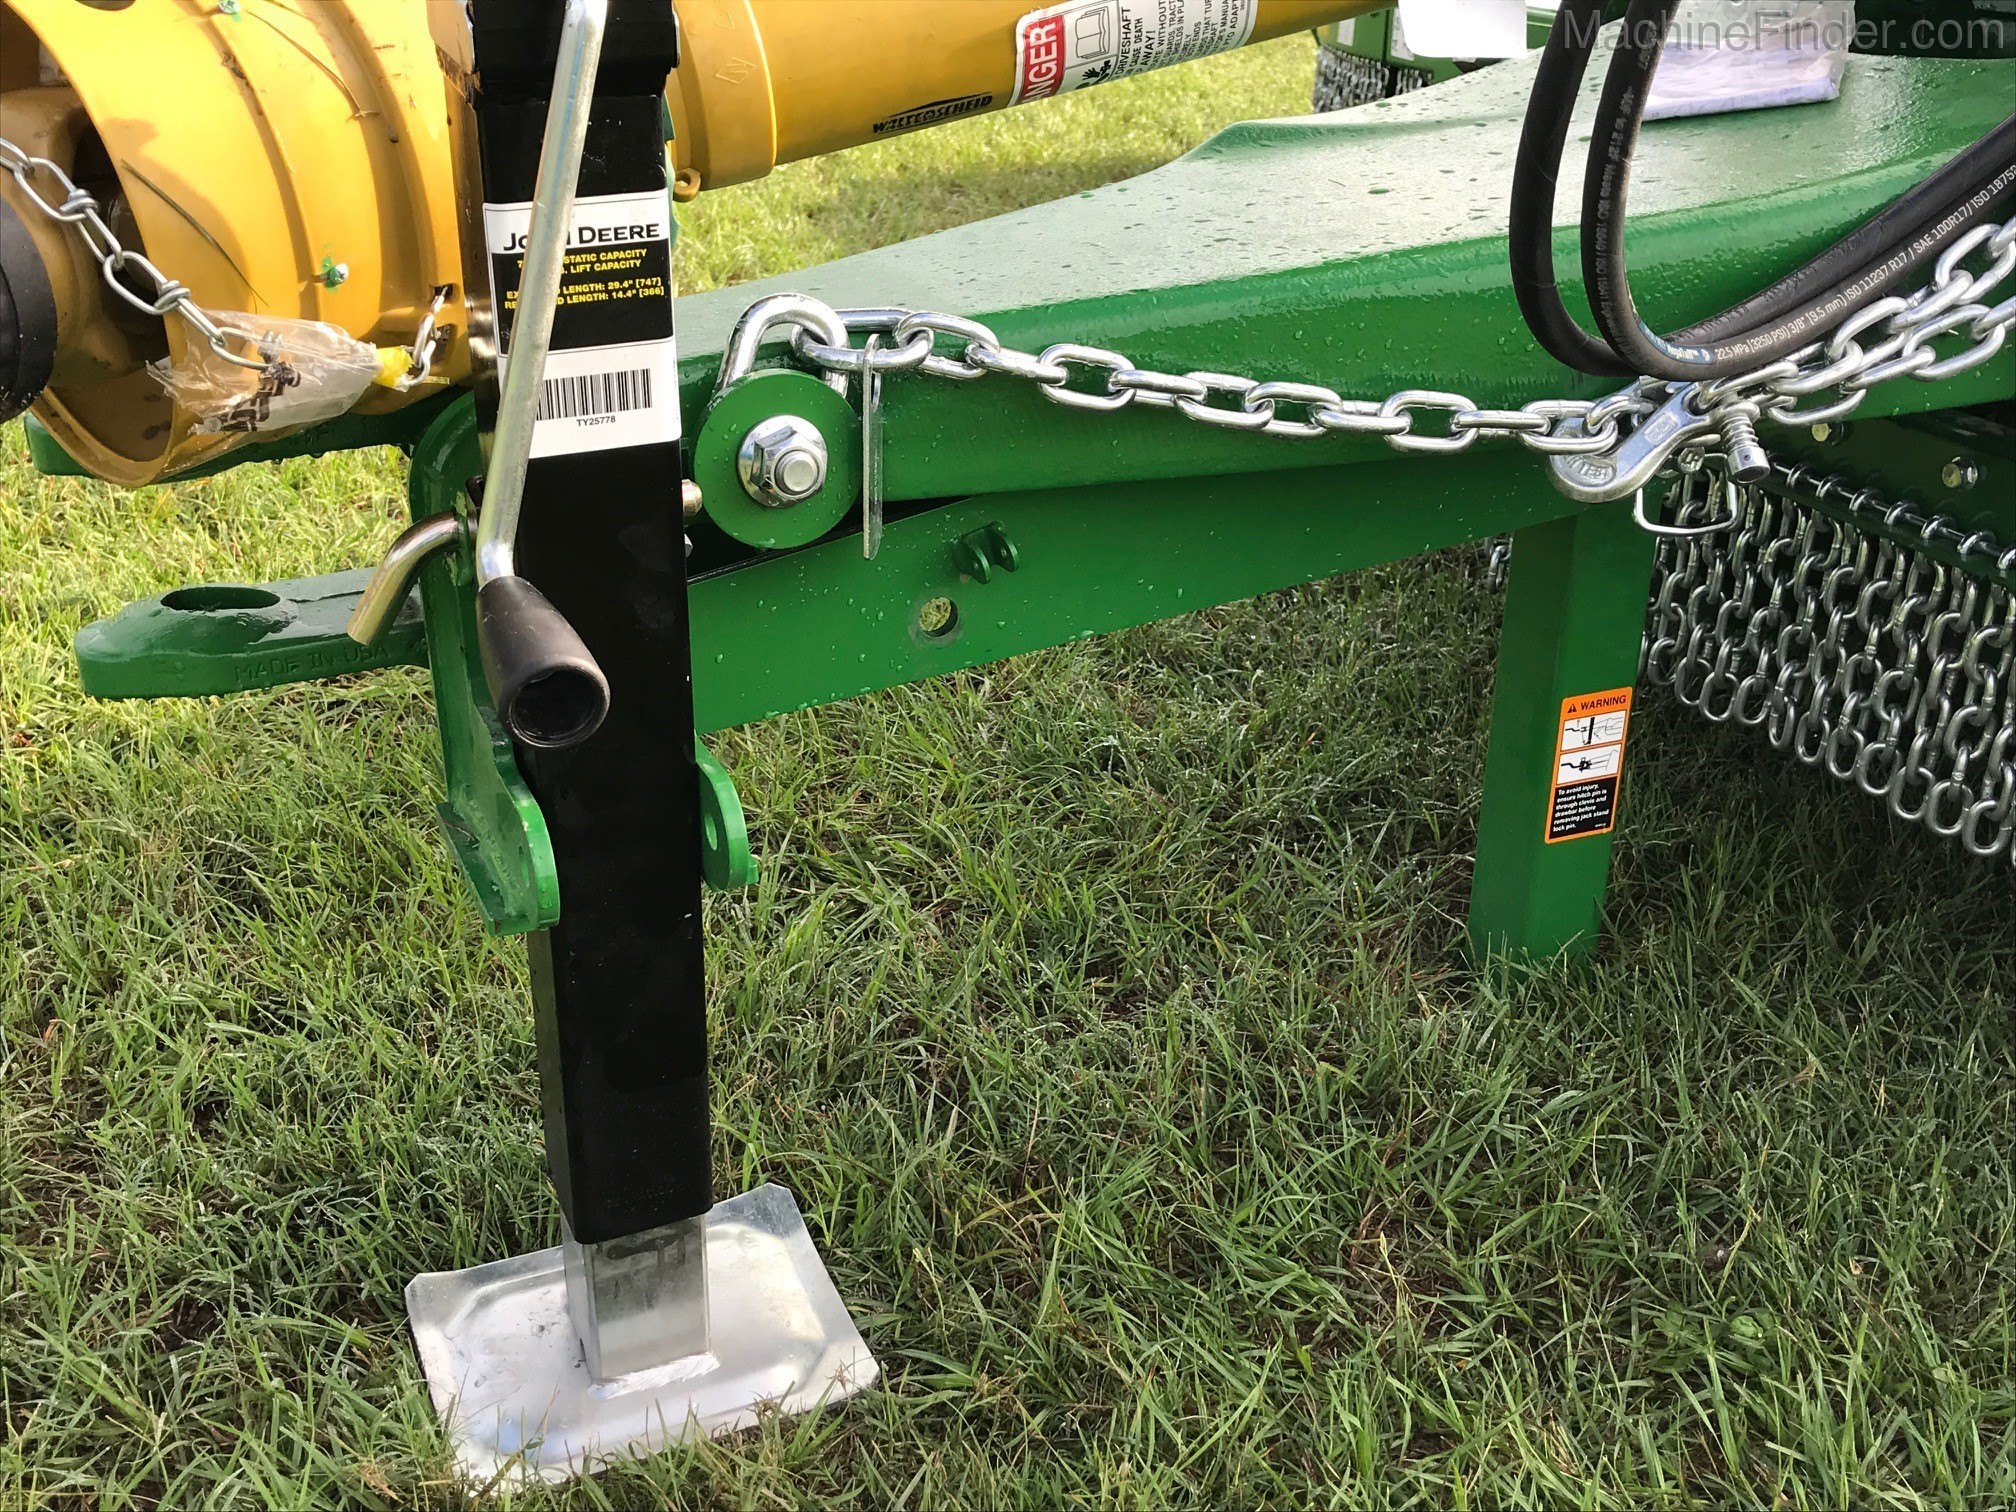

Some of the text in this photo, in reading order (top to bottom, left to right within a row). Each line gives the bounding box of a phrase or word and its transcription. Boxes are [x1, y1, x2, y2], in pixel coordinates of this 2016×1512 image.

[1157, 0, 1167, 48] WITHOUT
[1177, 15, 1184, 25] IN
[1202, 16, 1211, 35] THAT
[1134, 17, 1143, 44] DEATH
[1192, 21, 1201, 42] ENDS
[1115, 6, 1131, 75] DRIVESHAFT
[1140, 30, 1156, 66] AWAY!
[1021, 22, 1058, 103] ANGER
[578, 223, 660, 244] DEERE
[563, 249, 647, 264] STATIC CAPACITY
[570, 264, 590, 274] LIFT
[596, 259, 641, 272] CAPACITY
[1733, 339, 1750, 356] MPa
[1749, 333, 1773, 354] (3250
[1771, 322, 1791, 346] PSI)
[1790, 316, 1806, 335] 3/8"
[1807, 307, 1826, 327] (9.5
[1824, 293, 1847, 314] mm)
[1845, 284, 1862, 301] ISO
[1859, 265, 1889, 291] 11237
[1888, 252, 1909, 271] R17
[1913, 234, 1934, 254] SAE
[1969, 190, 1990, 209] ISO
[563, 283, 606, 294] LENGTH:
[608, 280, 634, 290] 29.4"
[636, 277, 661, 288] [747]
[567, 293, 609, 304] LENGTH:
[612, 289, 636, 299] 14.4"
[639, 286, 664, 298] [366]
[576, 416, 616, 427] TY25778
[234, 656, 299, 685] MADE
[307, 653, 336, 671] IN
[343, 645, 390, 663] USA
[1580, 695, 1627, 711] WARNING
[1557, 795, 1576, 803] ensure
[1592, 790, 1601, 798] pin
[1566, 786, 1581, 794] avoid
[1556, 801, 1577, 810] through
[1596, 795, 1607, 803] and
[1554, 815, 1580, 825] removing
[1593, 809, 1610, 817] stand
[1555, 805, 1596, 818] drawbar before
